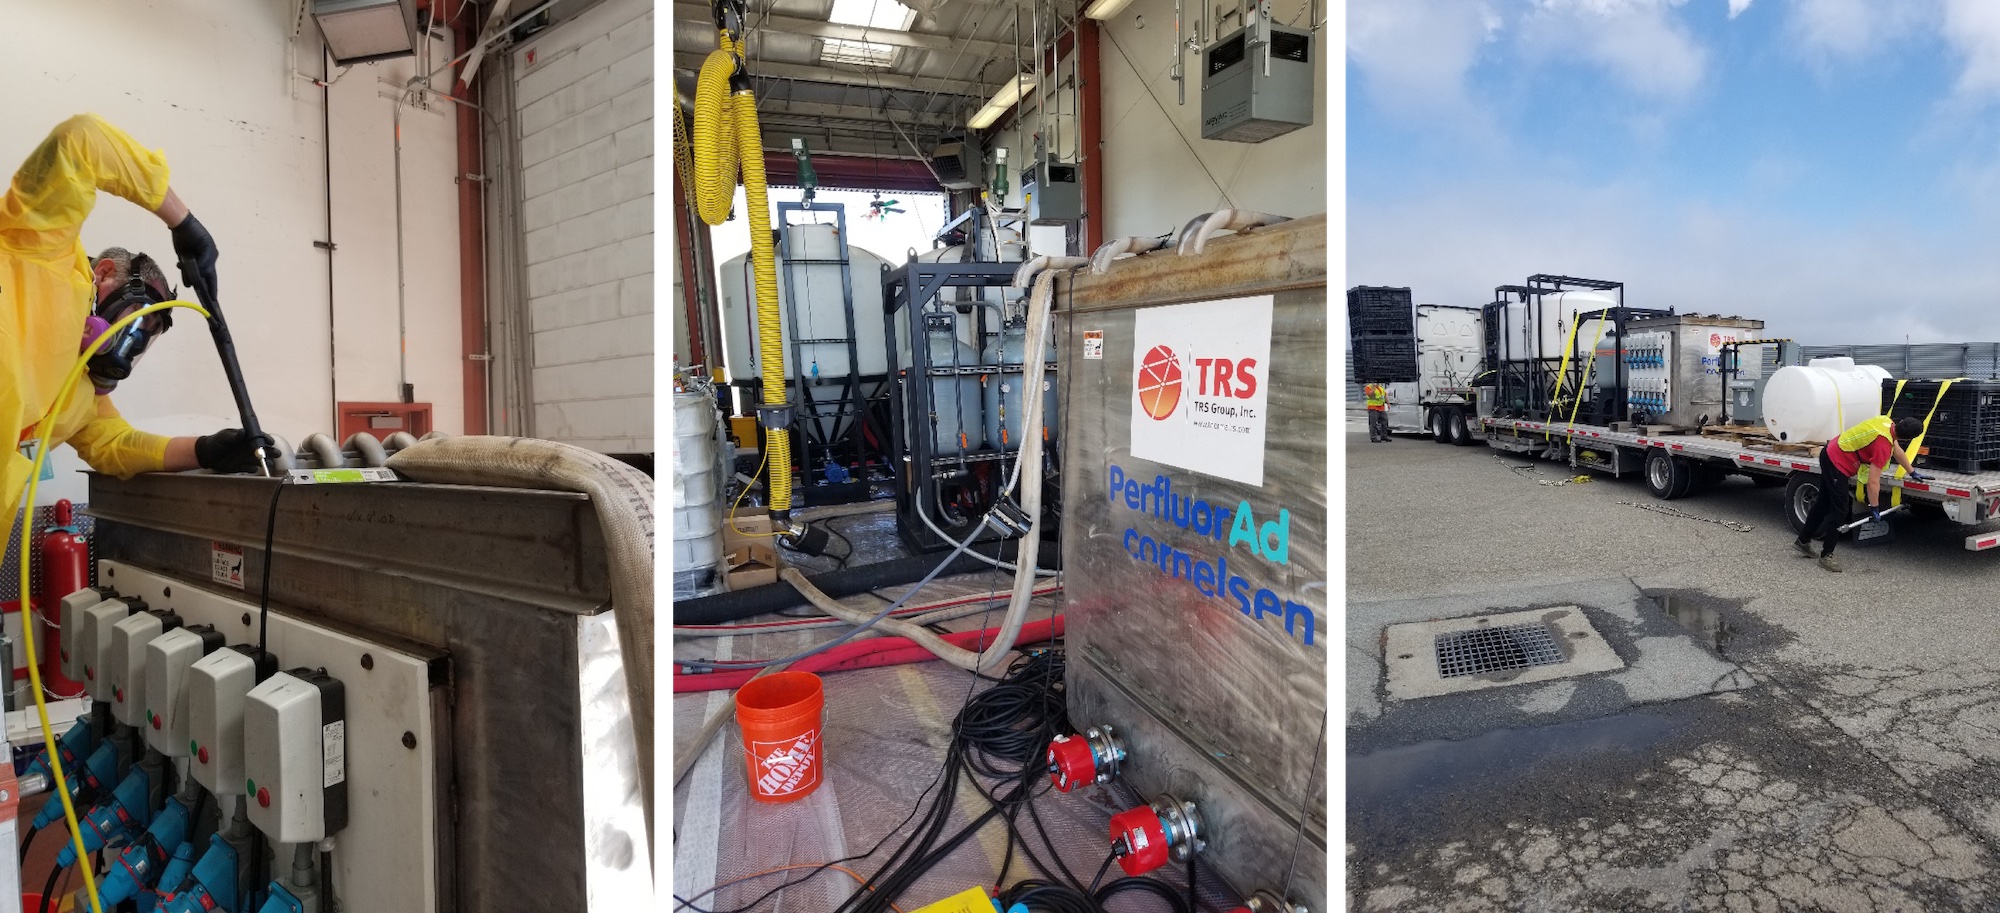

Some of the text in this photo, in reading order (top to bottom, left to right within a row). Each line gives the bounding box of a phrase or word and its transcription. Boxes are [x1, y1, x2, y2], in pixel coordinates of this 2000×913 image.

[1195, 357, 1257, 399] TRS
[1194, 401, 1256, 418] TRS Group, Inc.
[1109, 464, 1290, 566] PerfluorAd
[1124, 528, 1315, 645] cornelsen
[759, 734, 810, 795] HOME
[760, 747, 787, 771] THE
[781, 751, 815, 793] DEPOT
